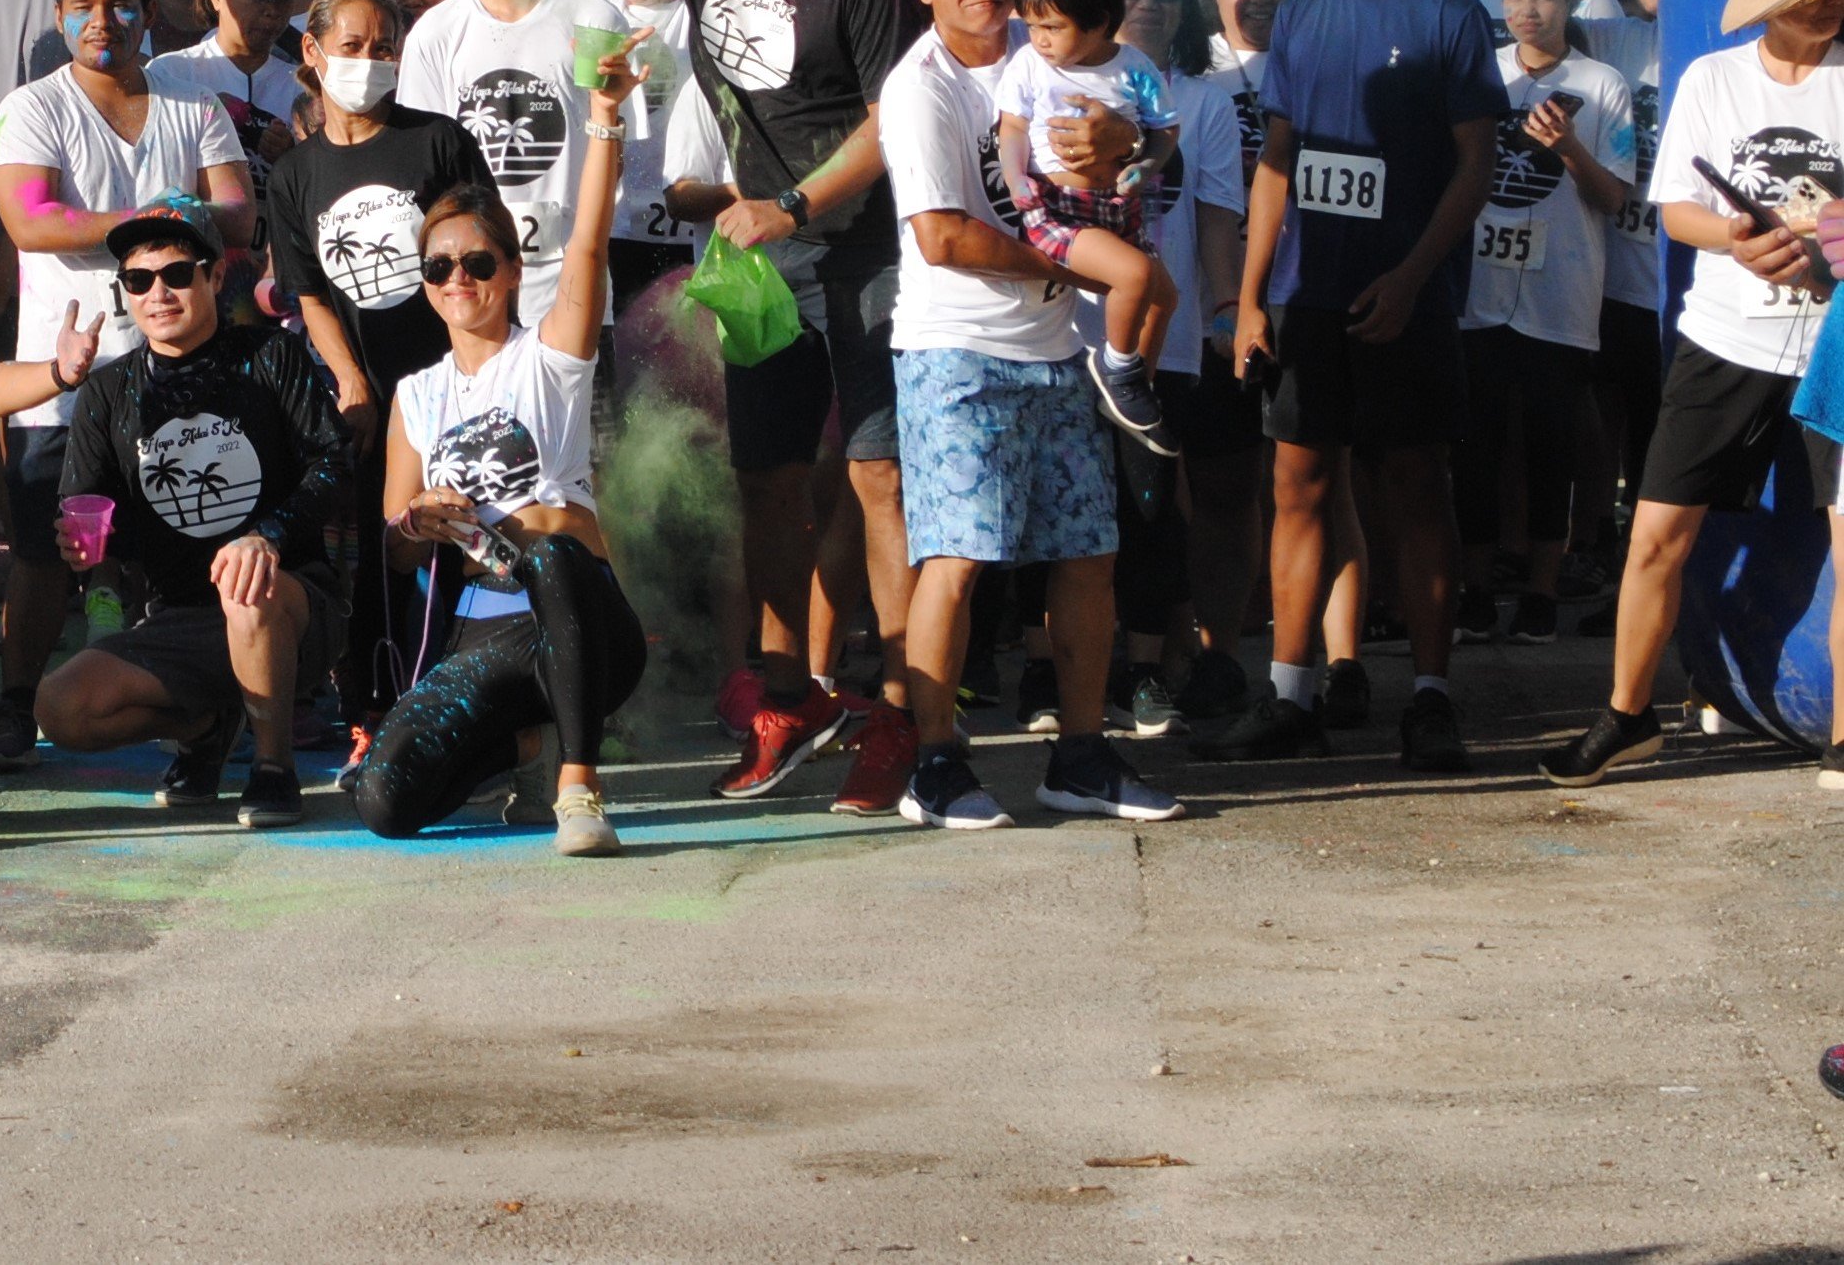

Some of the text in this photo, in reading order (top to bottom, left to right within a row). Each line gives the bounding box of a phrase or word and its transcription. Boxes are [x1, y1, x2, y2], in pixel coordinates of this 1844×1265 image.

[526, 79, 558, 98] 5K
[530, 101, 553, 112] 2022
[1807, 139, 1841, 159] 5K
[1808, 160, 1835, 172] 2022
[1303, 164, 1376, 209] 1138
[385, 189, 417, 207] 5K
[1478, 224, 1532, 261] 355
[210, 417, 245, 437] 5K
[492, 423, 515, 441] 2022
[217, 440, 241, 454] 2022
